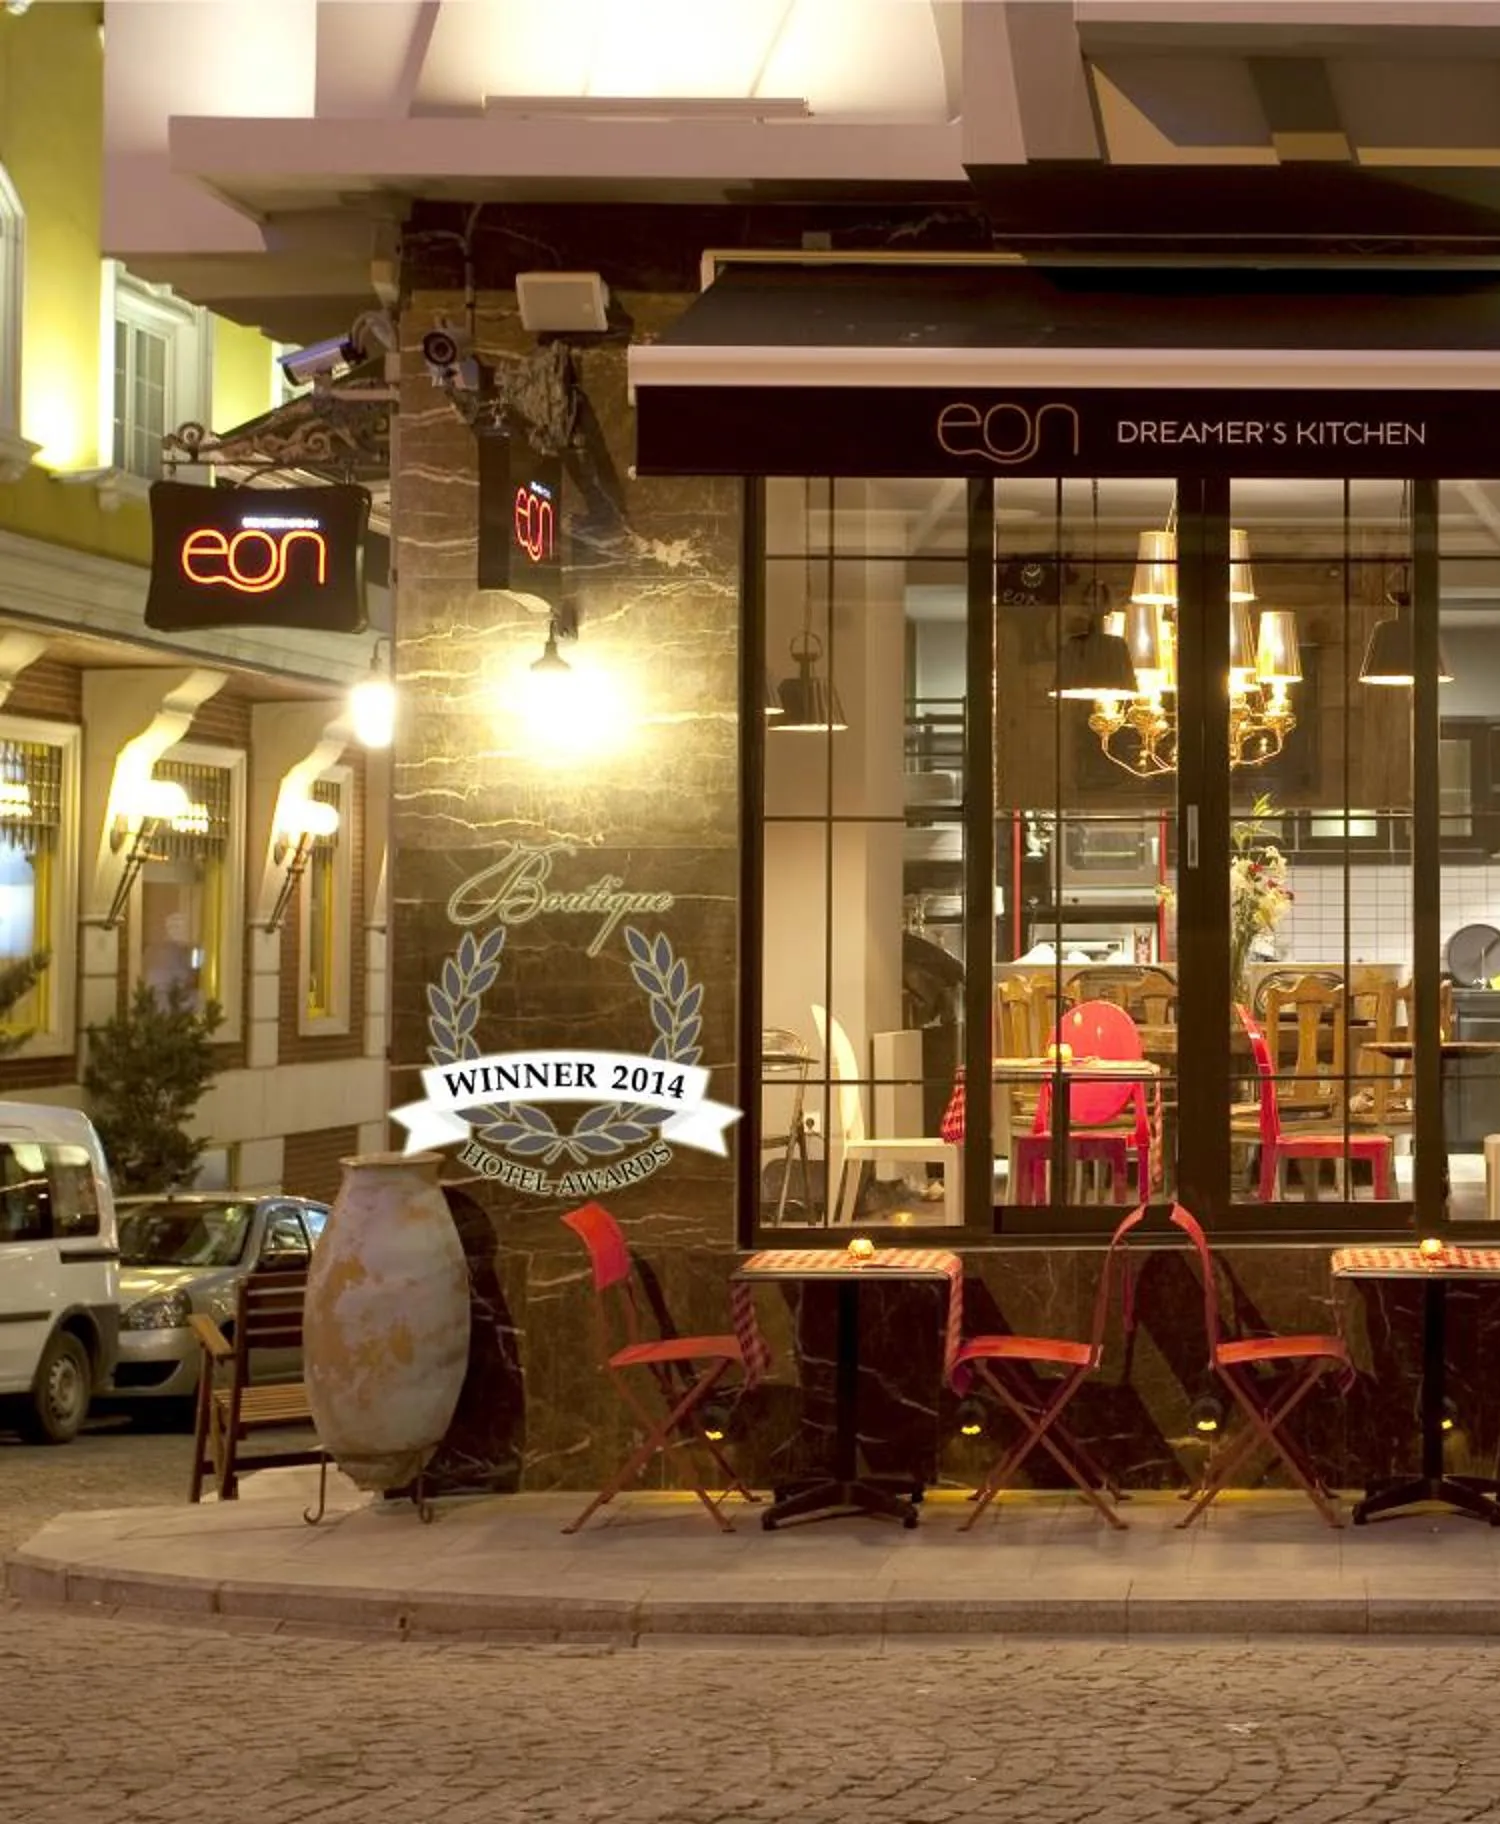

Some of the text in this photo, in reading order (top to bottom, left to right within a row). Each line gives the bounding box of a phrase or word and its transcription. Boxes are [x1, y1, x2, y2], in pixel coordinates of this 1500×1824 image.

[937, 402, 1427, 465] eon DREAMER'S KITCHEN
[514, 487, 553, 562] eon
[181, 528, 326, 593] eon
